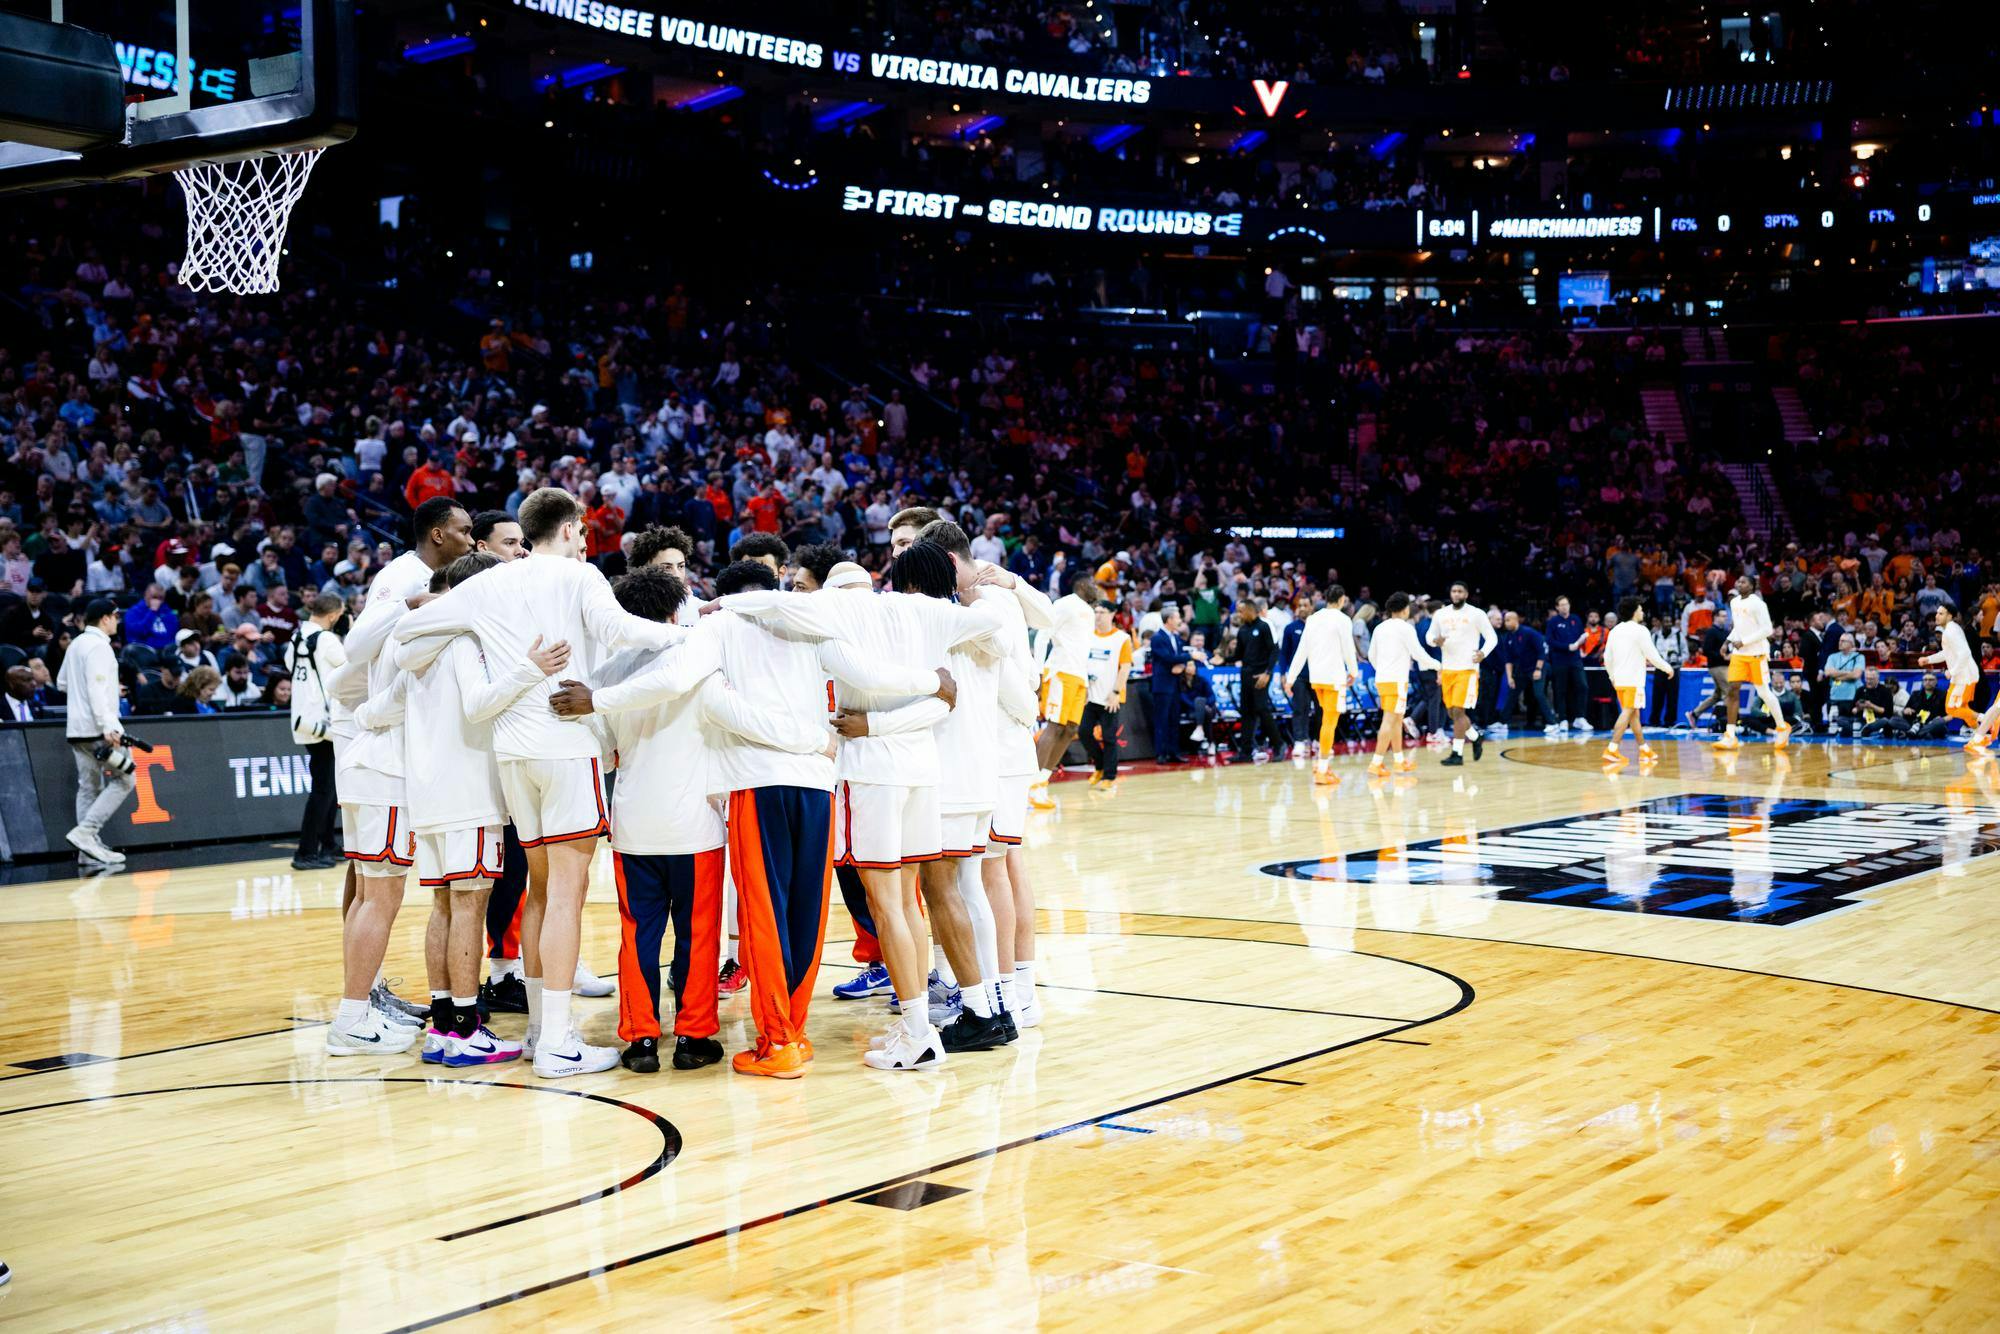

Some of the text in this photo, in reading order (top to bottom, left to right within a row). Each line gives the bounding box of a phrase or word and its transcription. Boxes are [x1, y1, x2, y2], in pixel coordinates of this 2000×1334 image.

[660, 16, 823, 69] VOLUNTEERS
[832, 50, 861, 73] VS
[871, 53, 999, 91] VIRGINIA
[1005, 68, 1152, 104] CAVALIERS
[876, 188, 960, 220] FIRST
[987, 198, 1092, 231] SECOND
[1097, 208, 1212, 236] ROUNDS
[1671, 204, 1931, 232] FG% 0 3PT% 0 FT% 0
[1428, 219, 1465, 237] 6:04
[1489, 215, 1643, 239] #MARCHMADNESS
[296, 664, 308, 682] 23
[228, 754, 313, 799] TENN
